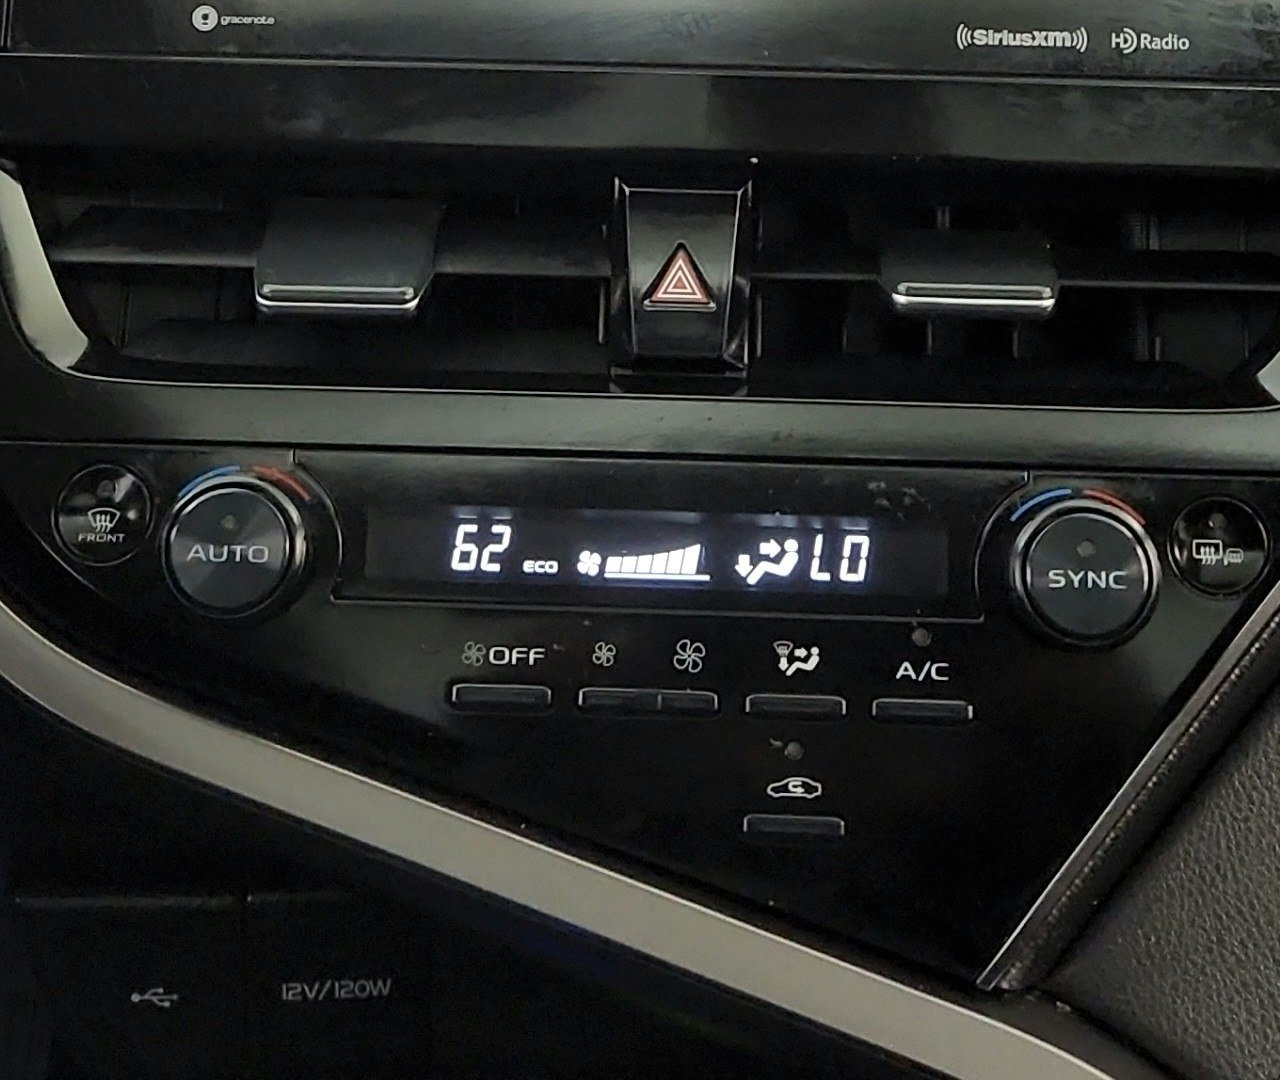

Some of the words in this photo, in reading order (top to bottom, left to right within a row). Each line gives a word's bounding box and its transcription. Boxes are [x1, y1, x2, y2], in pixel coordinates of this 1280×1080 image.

[1140, 32, 1190, 50] Radio
[77, 532, 125, 543] FRONT
[186, 543, 270, 563] AUTO
[450, 523, 512, 573] 62
[1048, 569, 1128, 589] SYNC
[488, 646, 546, 666] OFF
[895, 661, 949, 682] A/C
[281, 978, 392, 1001] 12V/120W
